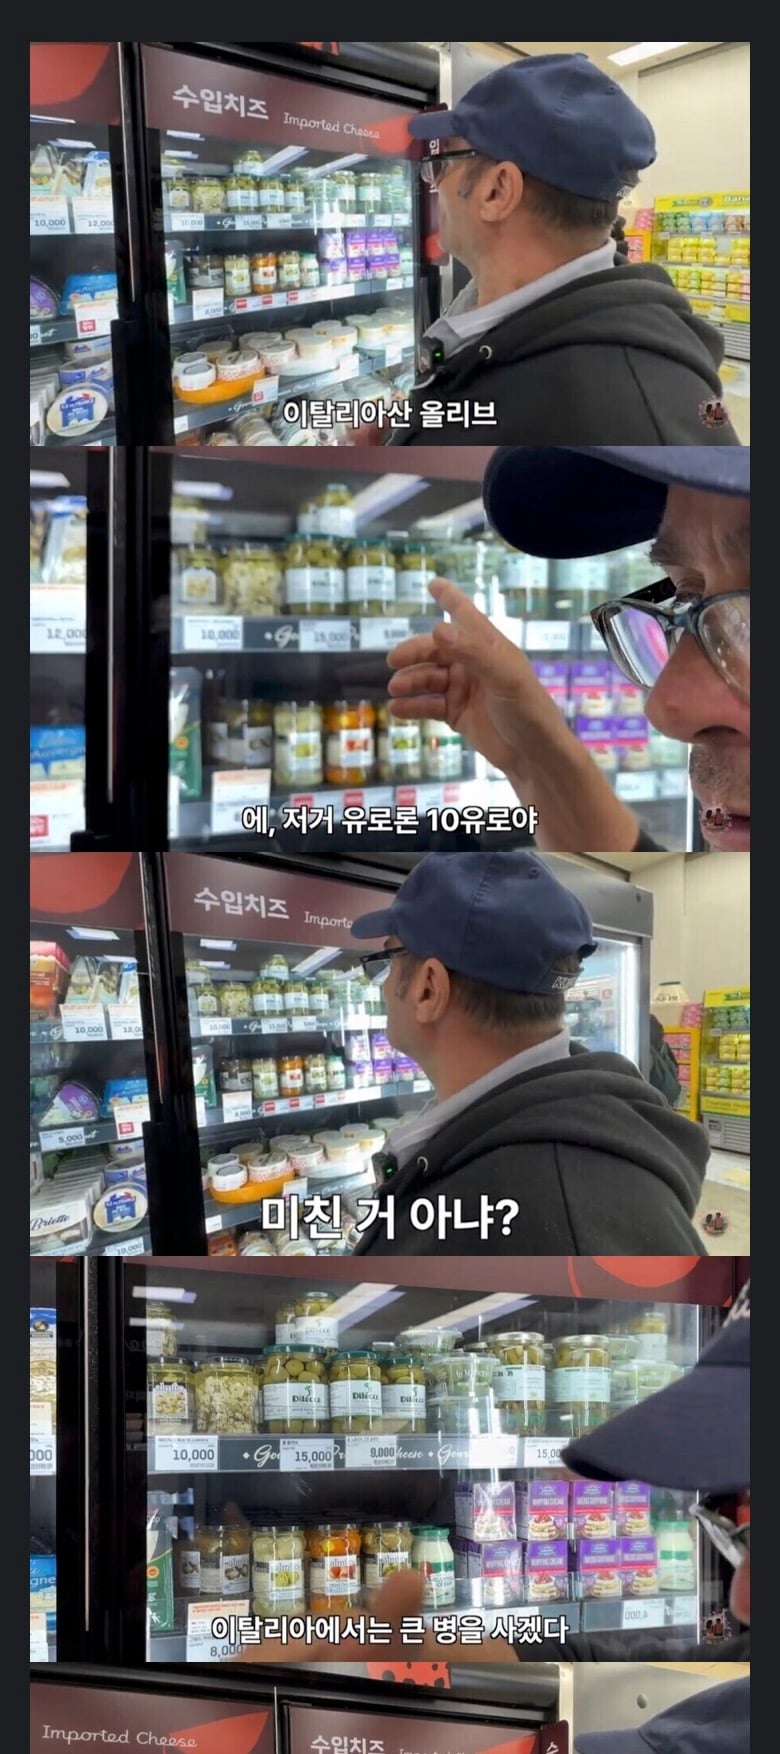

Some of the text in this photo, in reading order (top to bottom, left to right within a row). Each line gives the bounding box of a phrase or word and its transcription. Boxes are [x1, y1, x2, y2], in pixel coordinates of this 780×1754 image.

[172, 84, 269, 120] 수입치즈
[284, 112, 381, 140] Imported Cheese
[34, 218, 66, 228] 10,000
[194, 887, 290, 920] 수입치즈
[75, 1026, 104, 1035] 10,000
[58, 1135, 84, 1144] 5,000
[172, 1449, 215, 1462] 10,000
[295, 1451, 332, 1463] 15,000
[370, 1447, 396, 1459] 9,000
[210, 1645, 244, 1658] 8,000
[42, 1725, 198, 1748] Imported Cheese
